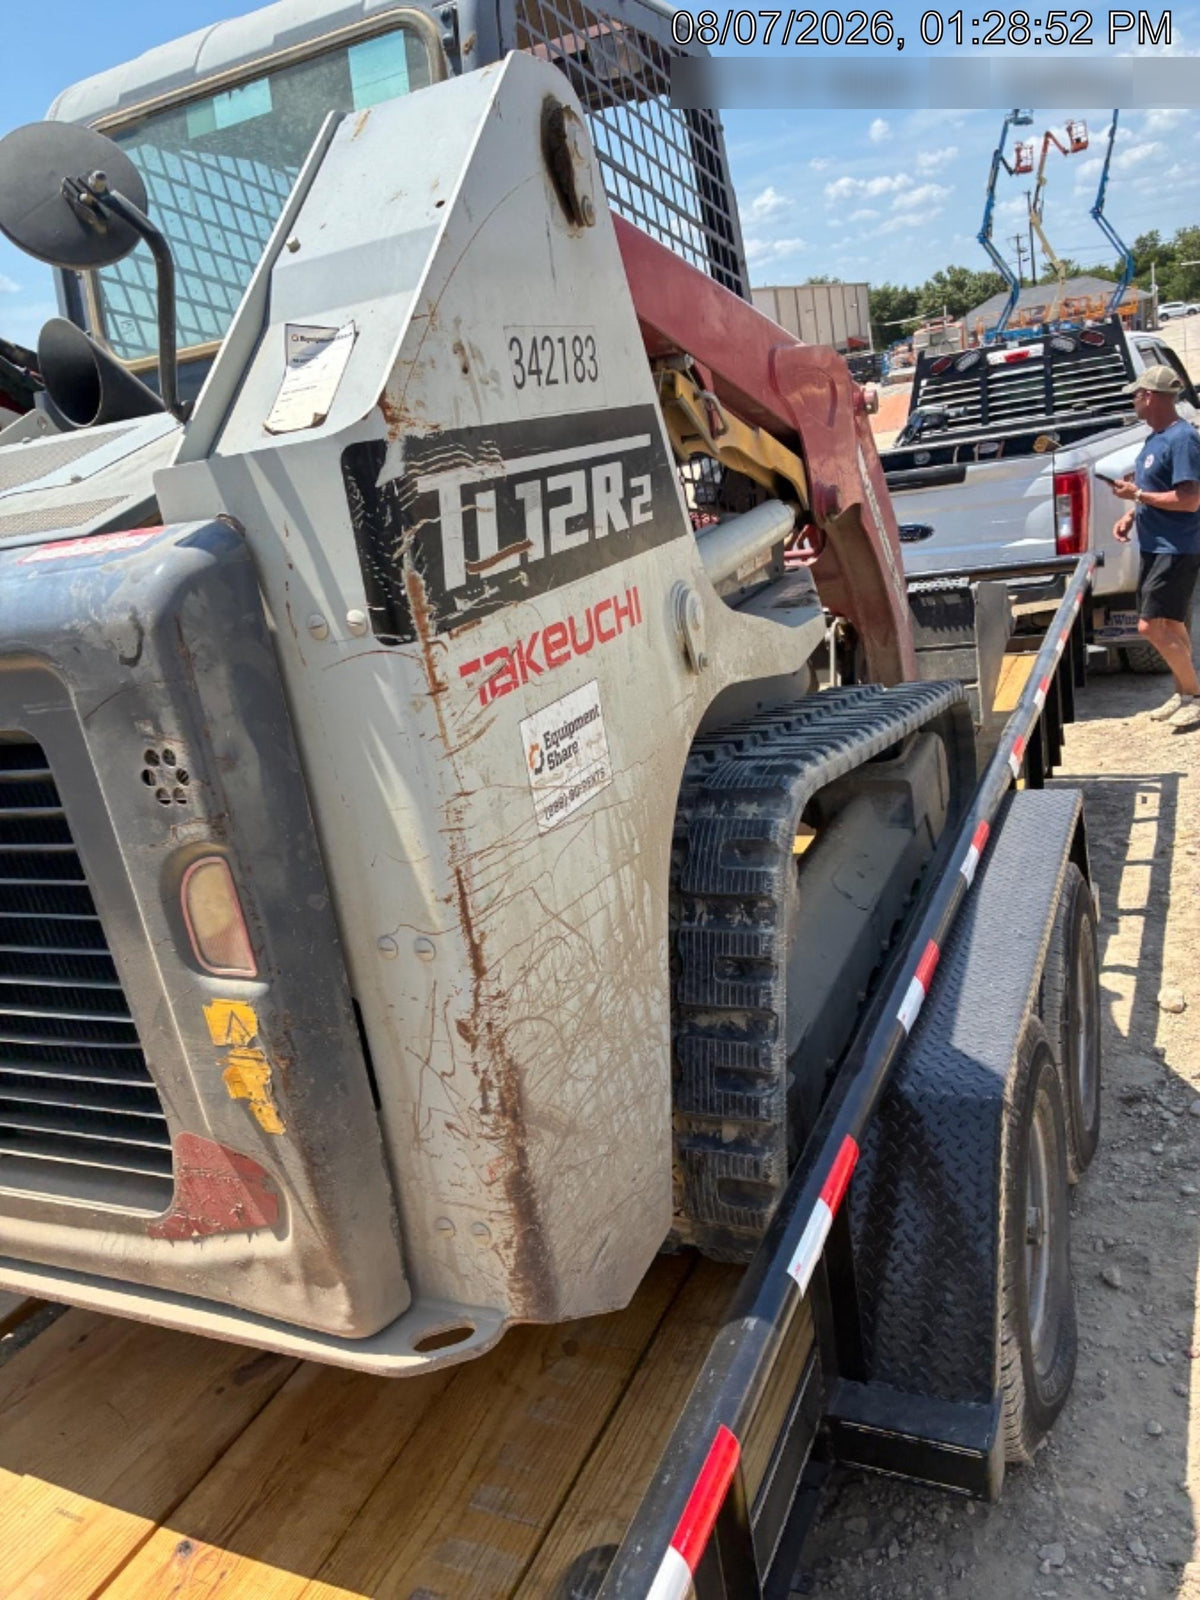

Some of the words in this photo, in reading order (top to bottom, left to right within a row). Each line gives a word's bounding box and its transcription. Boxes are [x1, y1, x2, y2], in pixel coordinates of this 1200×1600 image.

[509, 335, 599, 390] 342183
[543, 704, 600, 750] Equipment
[547, 741, 579, 770] Share
